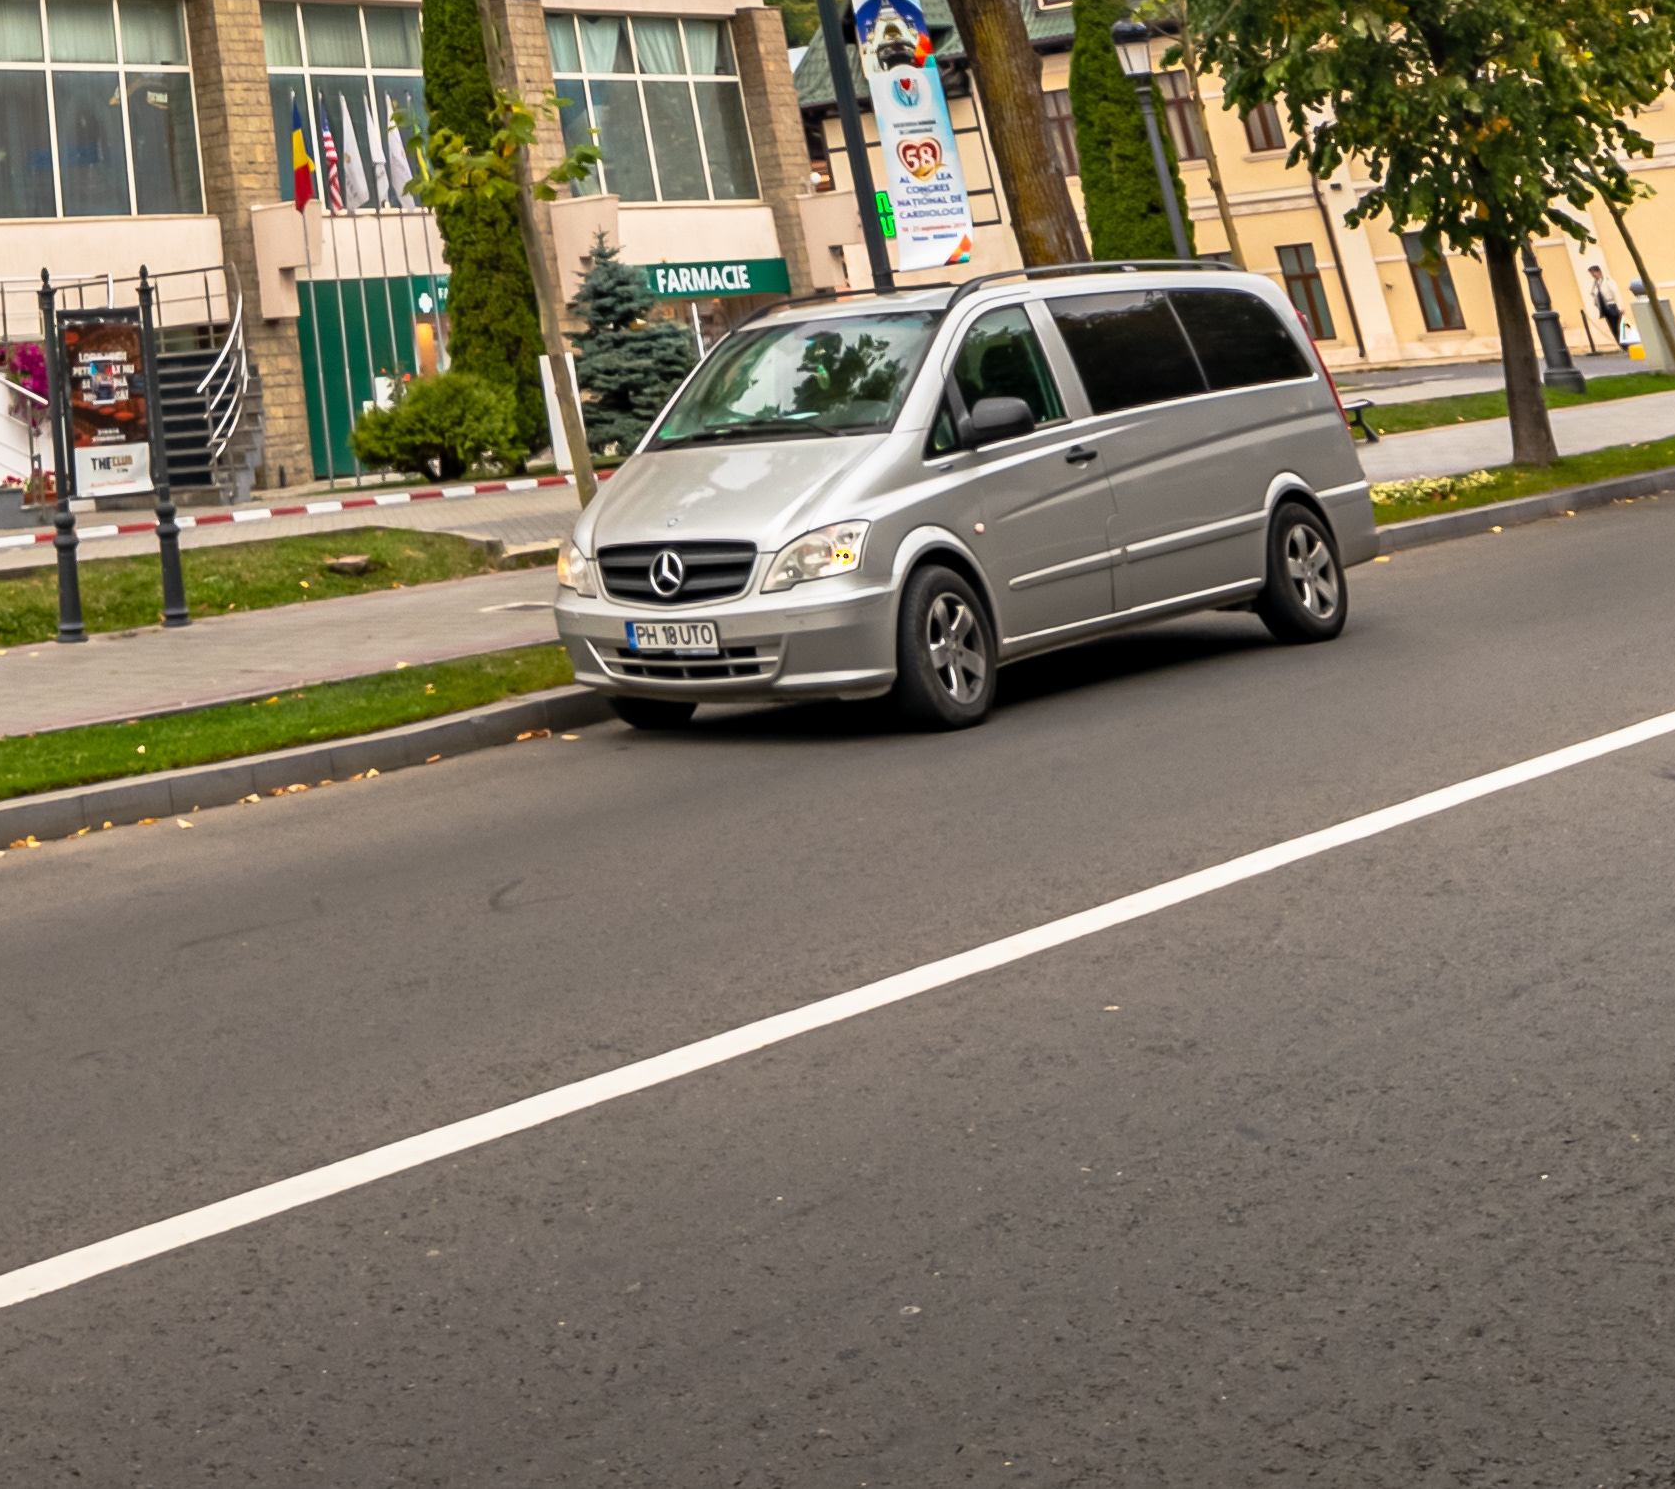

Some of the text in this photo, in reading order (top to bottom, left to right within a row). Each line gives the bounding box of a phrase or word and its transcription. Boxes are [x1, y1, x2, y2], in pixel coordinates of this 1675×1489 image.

[905, 145, 936, 171] 58
[906, 183, 950, 194] CONGRES
[950, 194, 962, 203] DE
[899, 207, 964, 219] CARDIOLOGIE
[656, 265, 750, 293] FARMACIE
[635, 624, 713, 645] PH 18 UTO
